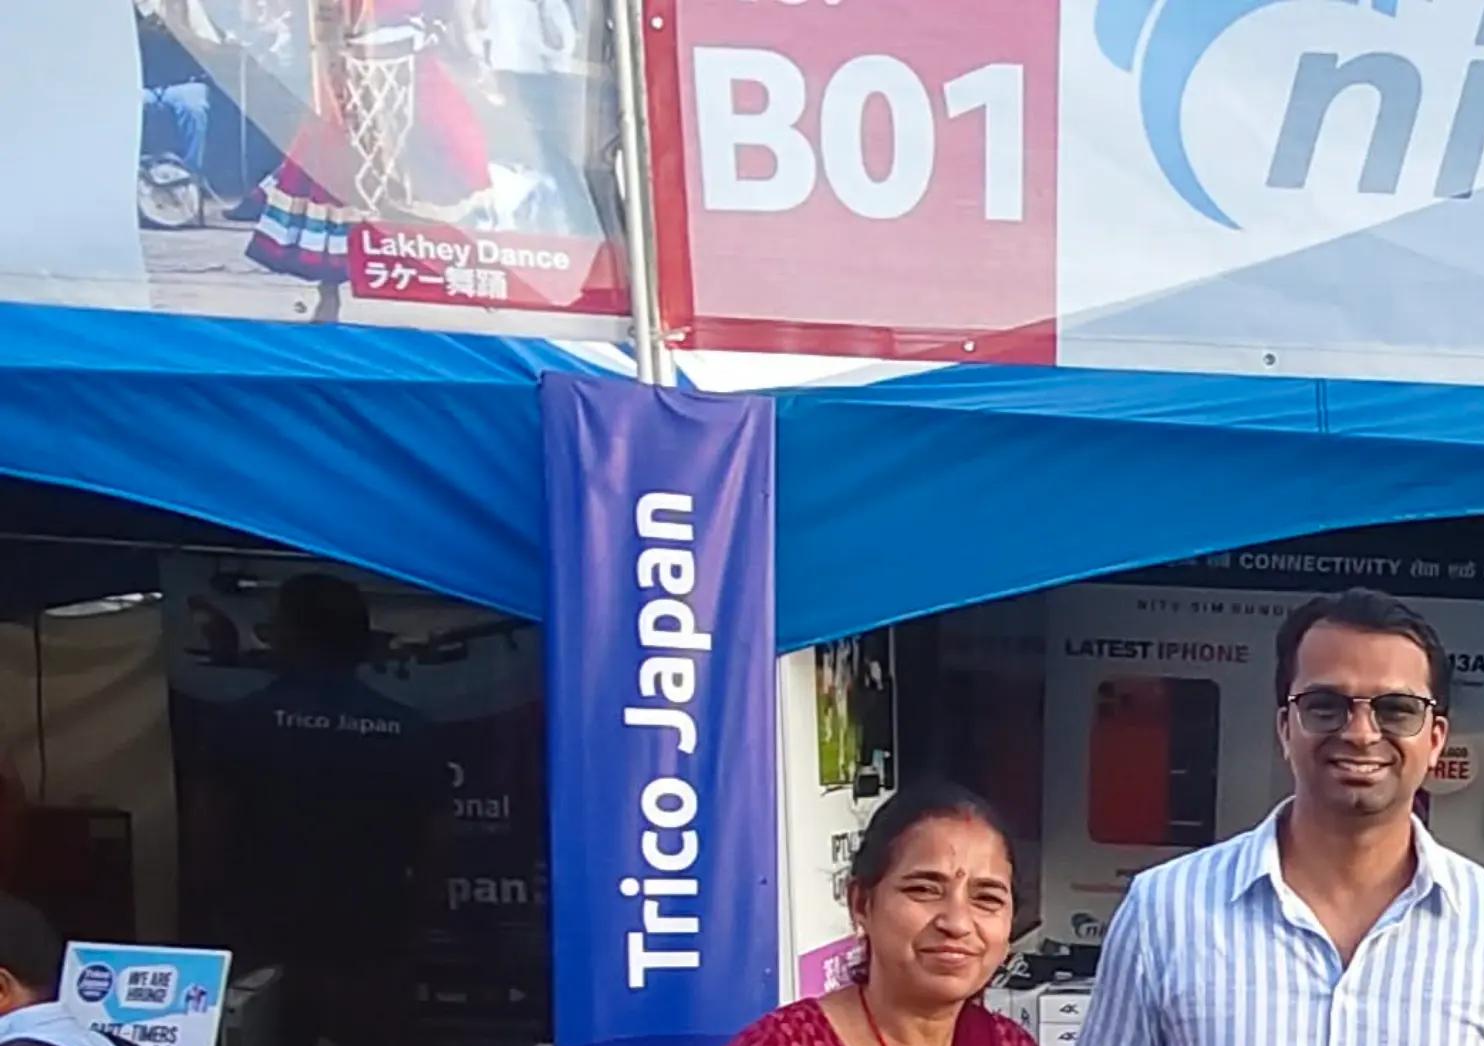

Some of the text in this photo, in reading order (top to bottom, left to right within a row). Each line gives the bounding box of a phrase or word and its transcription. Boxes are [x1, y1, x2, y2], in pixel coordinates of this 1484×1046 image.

[694, 46, 1024, 222] B01
[362, 230, 569, 269] Lakhey Dance
[1239, 553, 1400, 577] CONNECTIVITY
[1065, 638, 1249, 664] LATEST IPHONE
[274, 708, 401, 735] Trico Japan
[620, 492, 712, 988] Trico Japan
[447, 875, 527, 911] pan
[151, 971, 173, 987] ARE
